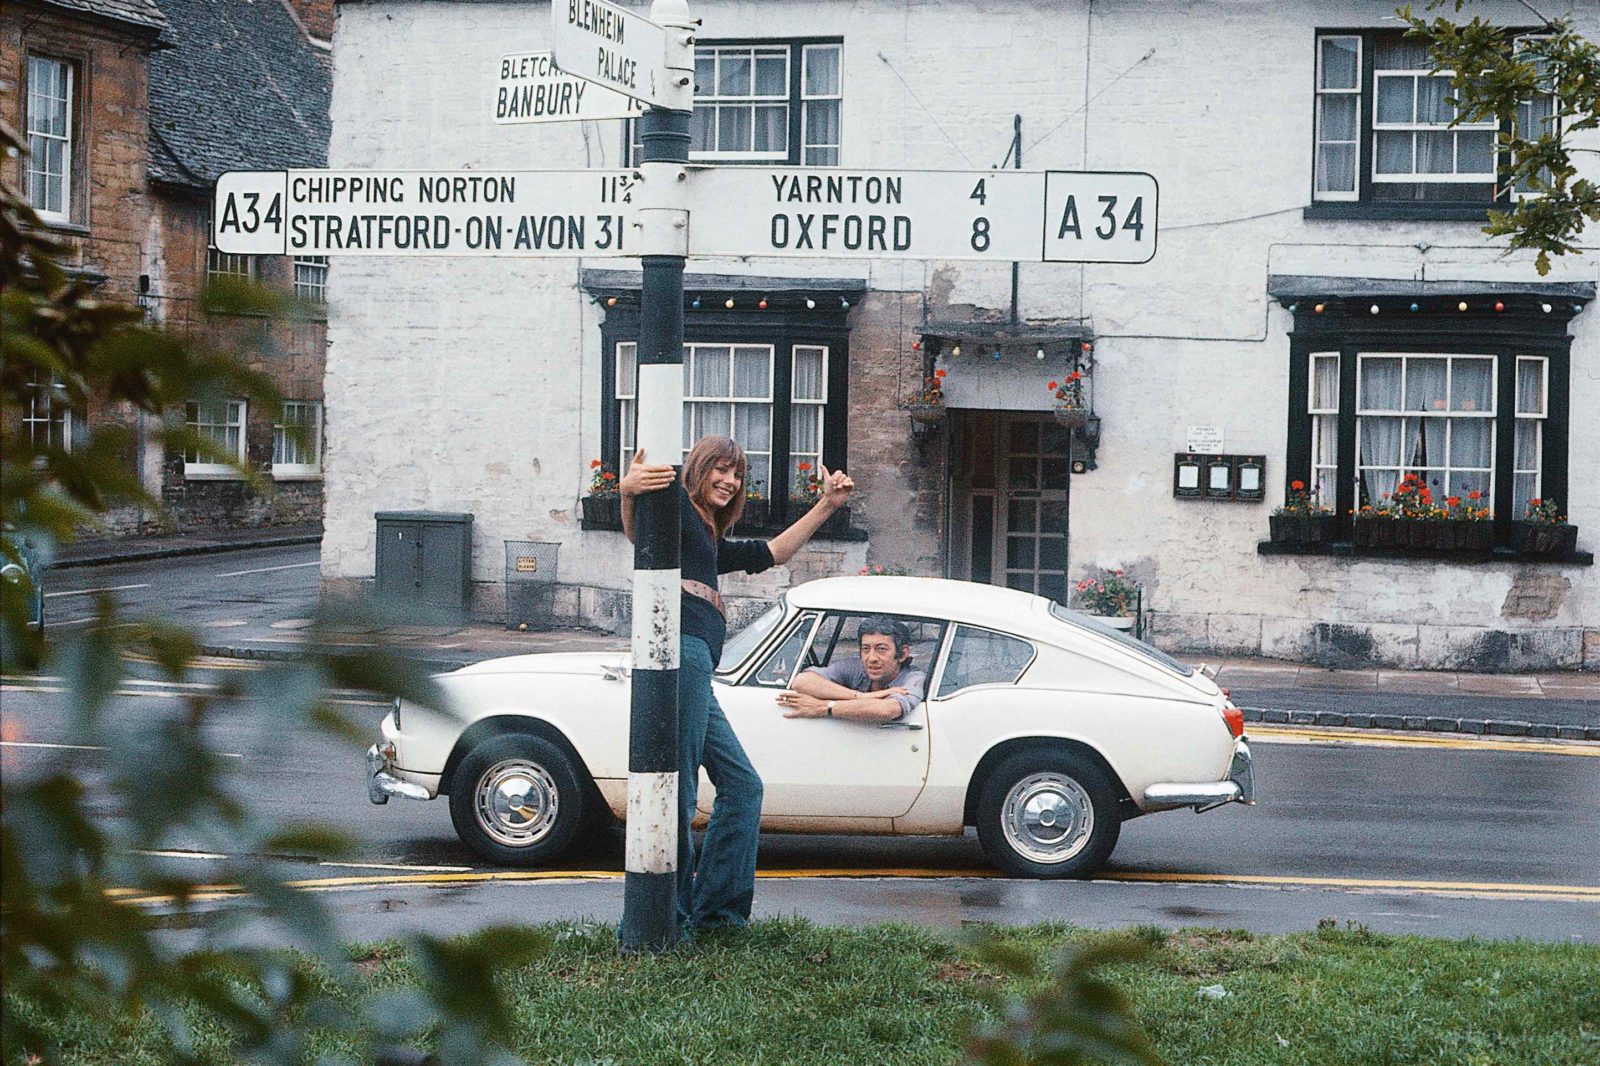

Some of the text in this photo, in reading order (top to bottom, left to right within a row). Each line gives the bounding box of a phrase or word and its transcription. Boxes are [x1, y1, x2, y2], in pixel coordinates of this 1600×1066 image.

[568, 0, 624, 44] BLENHEIM
[598, 46, 636, 89] PALACE
[496, 81, 587, 119] BANBURY
[293, 177, 404, 203] CHIPPING
[419, 177, 515, 203] NORTON
[772, 175, 986, 206] YARNTON 4
[219, 192, 281, 234] A34
[291, 215, 624, 250] STRATFORD-ON-AVON 31
[771, 214, 990, 252] OXFORD 8
